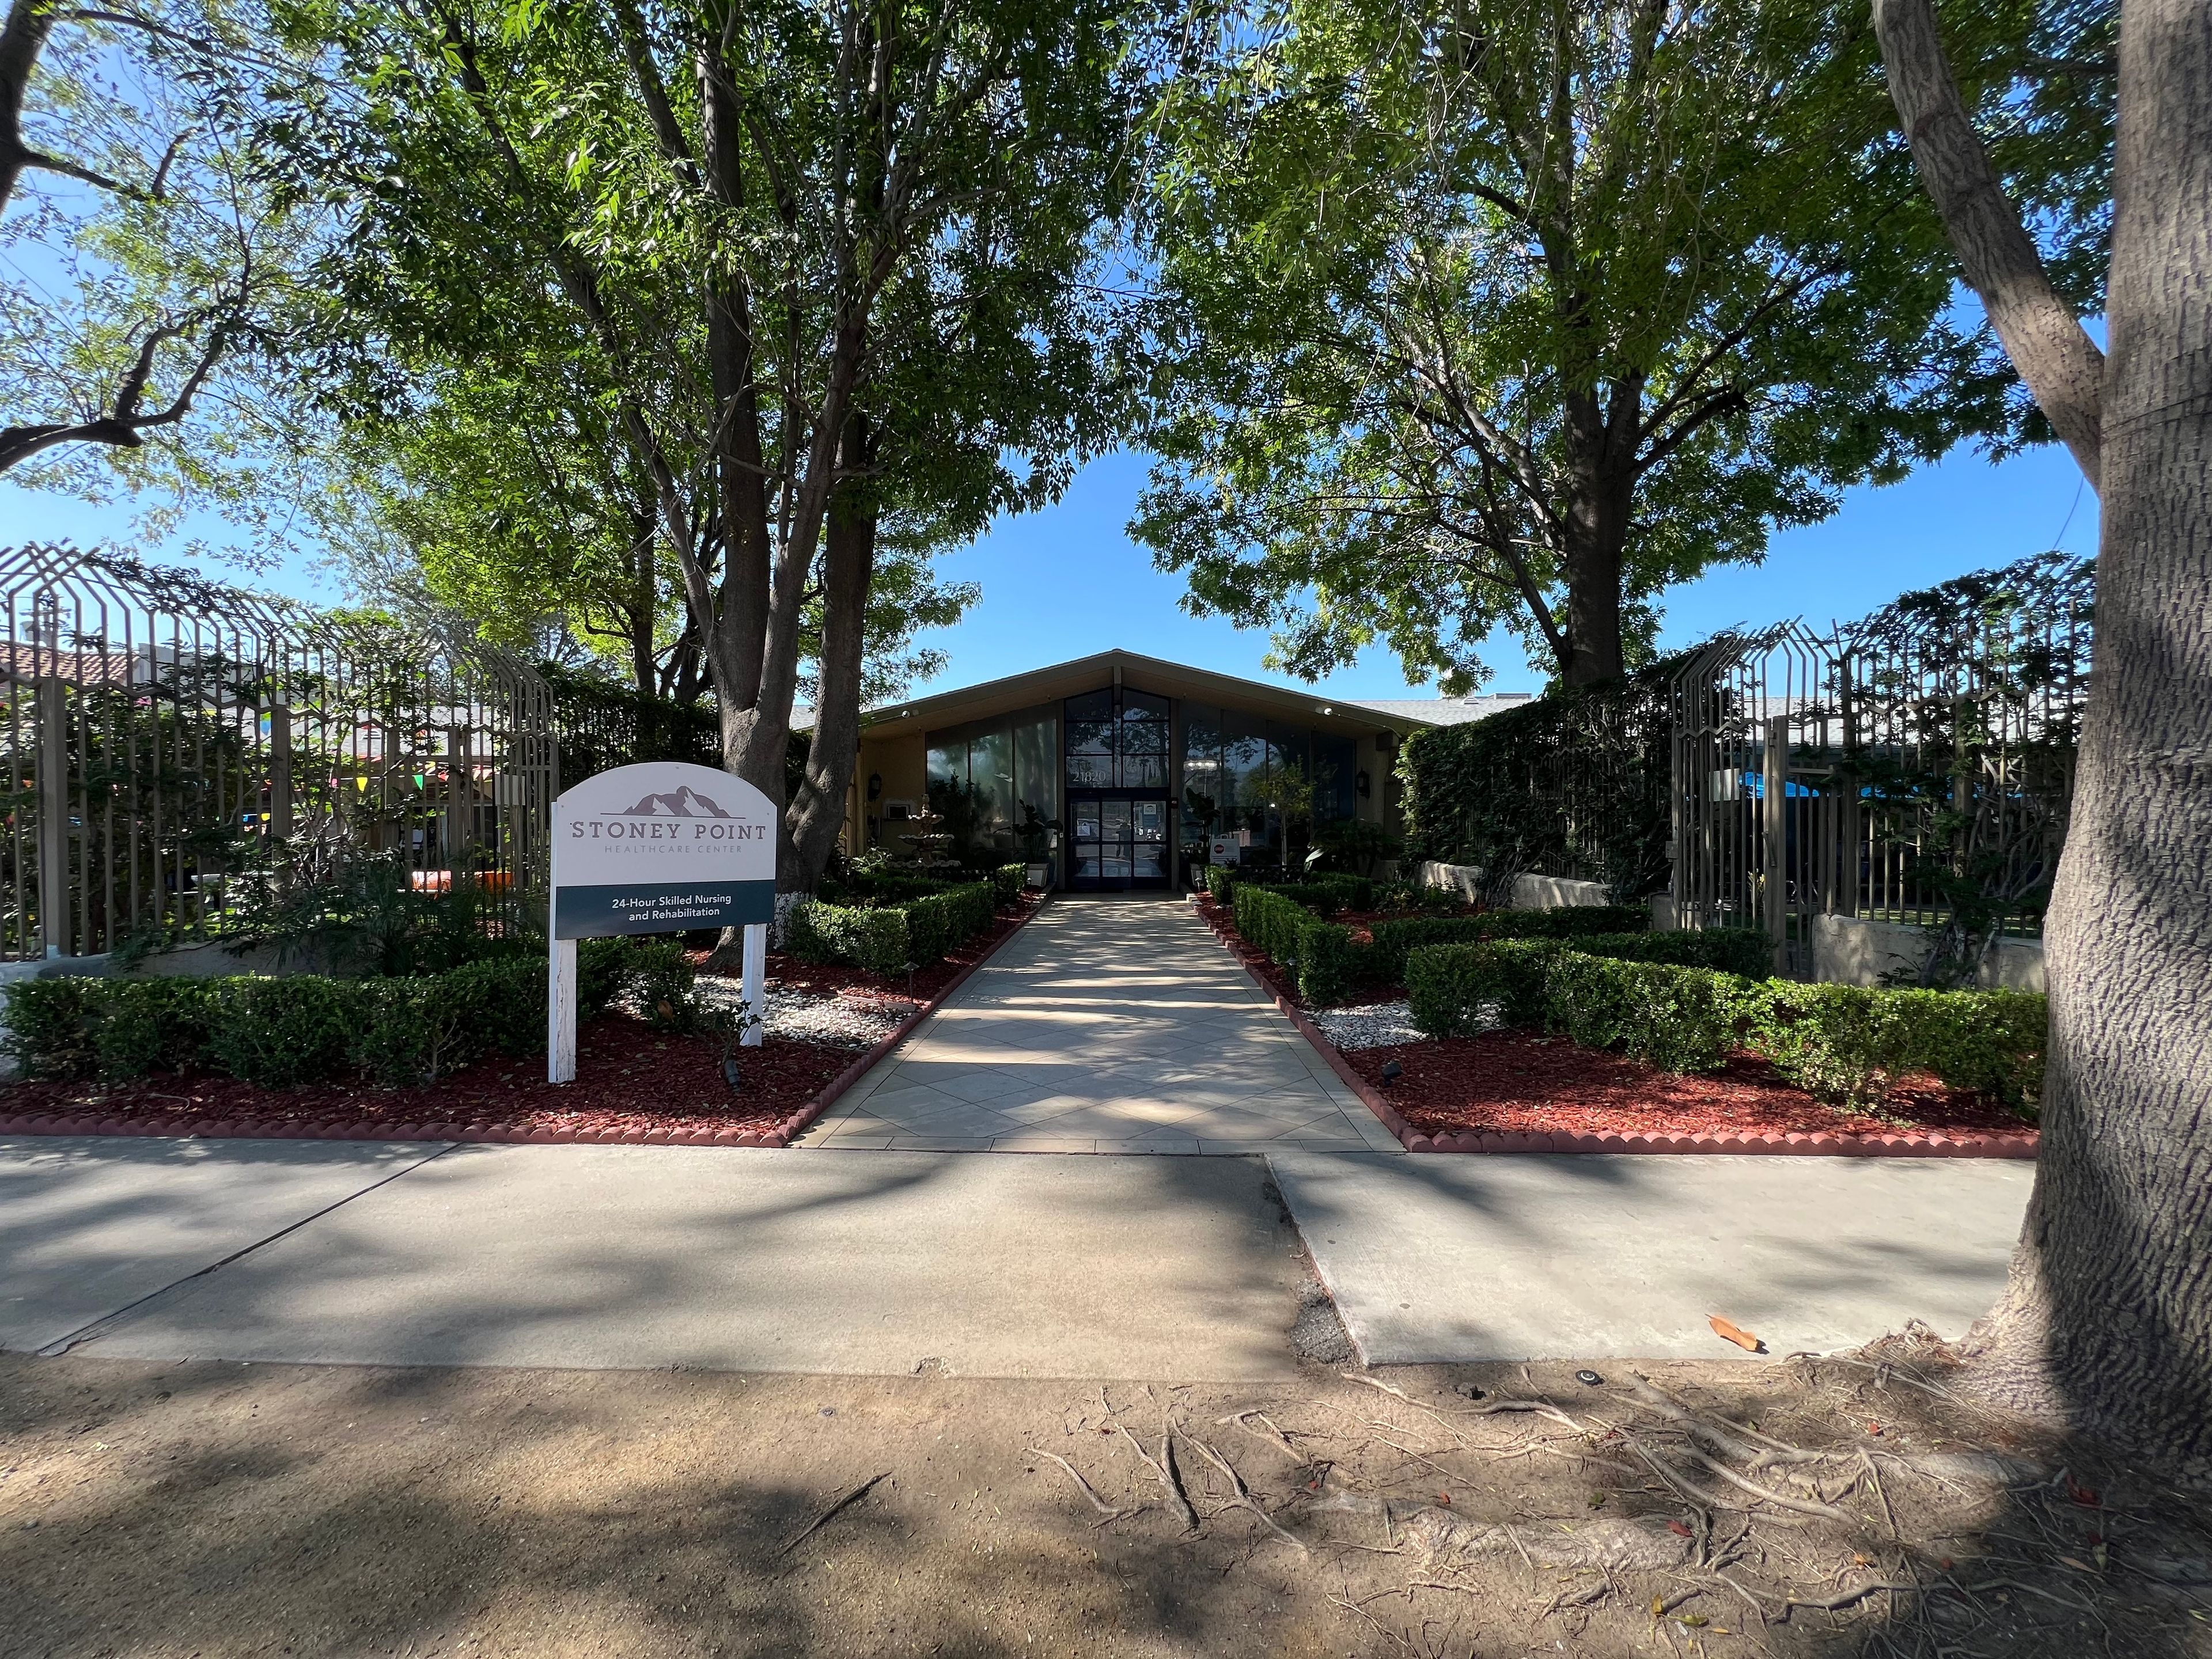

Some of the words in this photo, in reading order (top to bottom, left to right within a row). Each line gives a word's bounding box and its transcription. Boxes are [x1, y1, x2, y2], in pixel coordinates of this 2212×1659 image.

[1073, 770, 1106, 782] 21820
[572, 821, 680, 839] STONEY
[695, 824, 766, 840] POINT
[604, 844, 691, 854] HEALTHCARE
[698, 844, 743, 853] CENTER
[612, 897, 656, 909] 24-Hour
[658, 895, 692, 906] Skilled
[695, 894, 732, 905] Nursing
[628, 911, 649, 921] and
[652, 907, 720, 920] Rehabilitation
